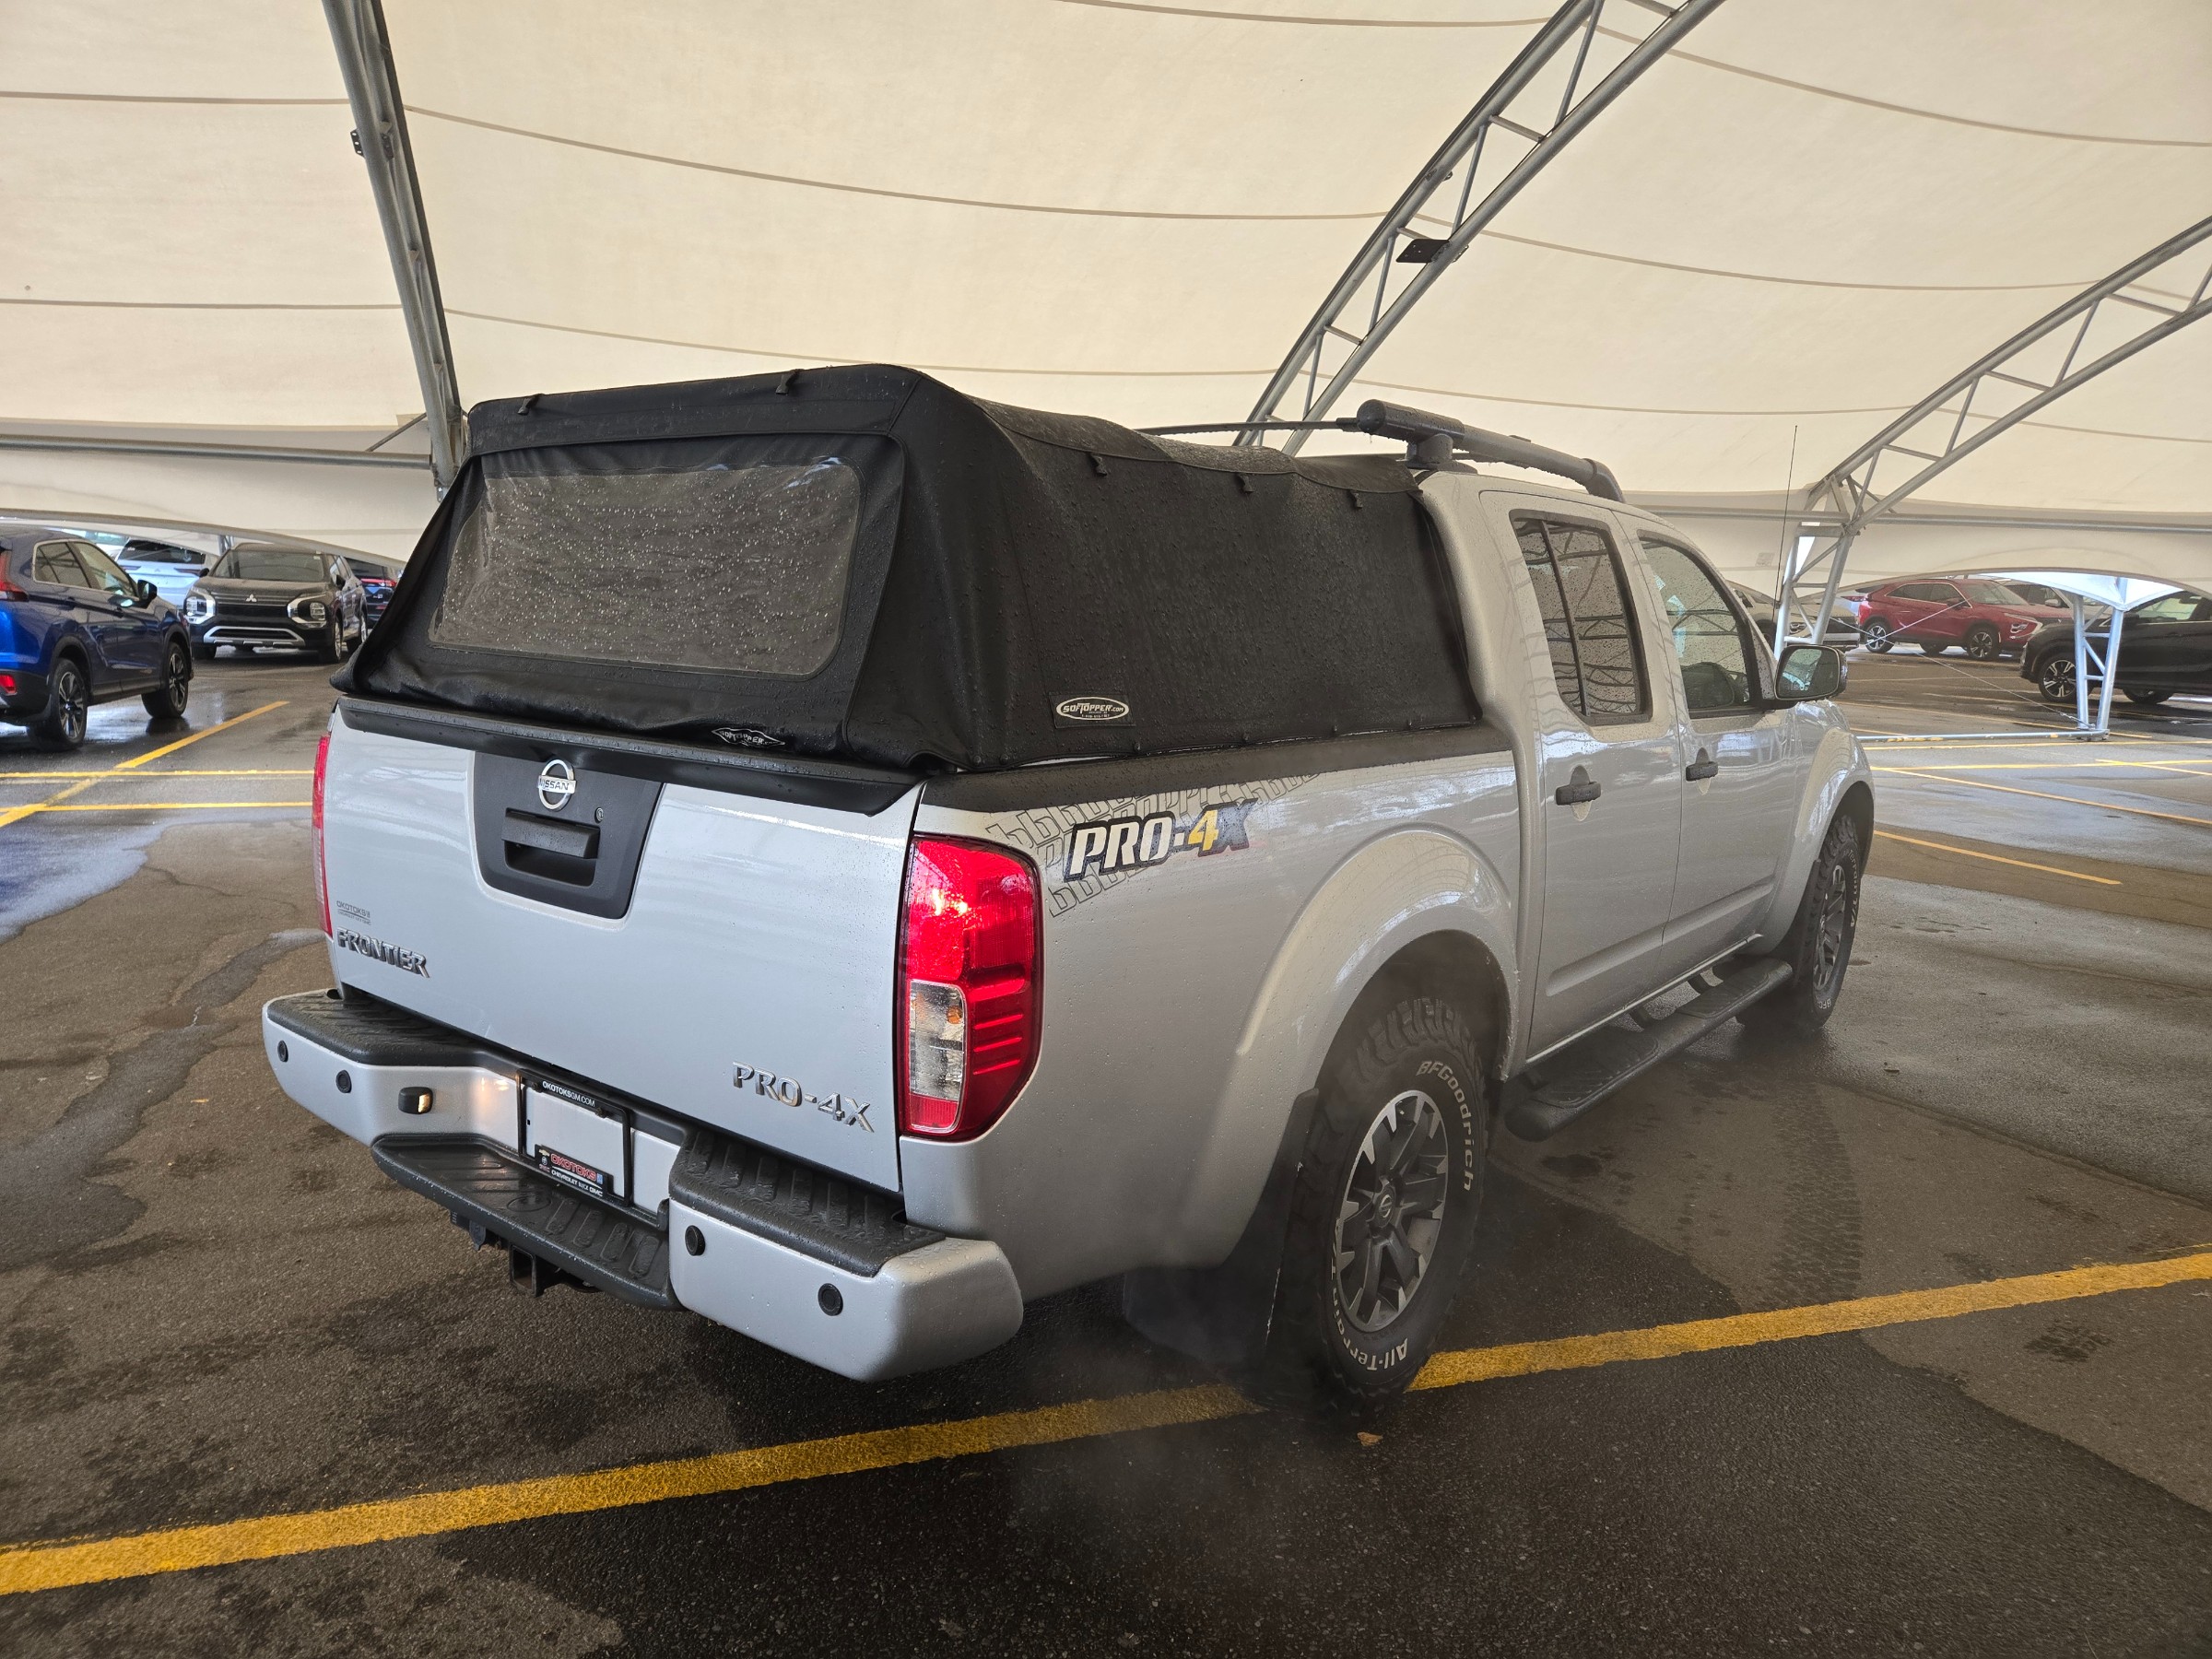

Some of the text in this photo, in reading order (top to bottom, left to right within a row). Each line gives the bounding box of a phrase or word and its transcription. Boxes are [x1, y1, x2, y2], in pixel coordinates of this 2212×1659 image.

[538, 778, 570, 791] NISSAN
[1064, 797, 1258, 882] PRO-4X
[336, 900, 367, 917] OKOTOKS
[336, 926, 430, 979] FRONTIER
[542, 1080, 595, 1108] OKOTOKSGM.COM
[733, 1061, 875, 1133] PRO-4X
[1416, 1061, 1475, 1191] BFGoodrich
[550, 1153, 596, 1182] OKOTOKS
[551, 1170, 578, 1184] CHEVROLET
[589, 1186, 604, 1197] GMC
